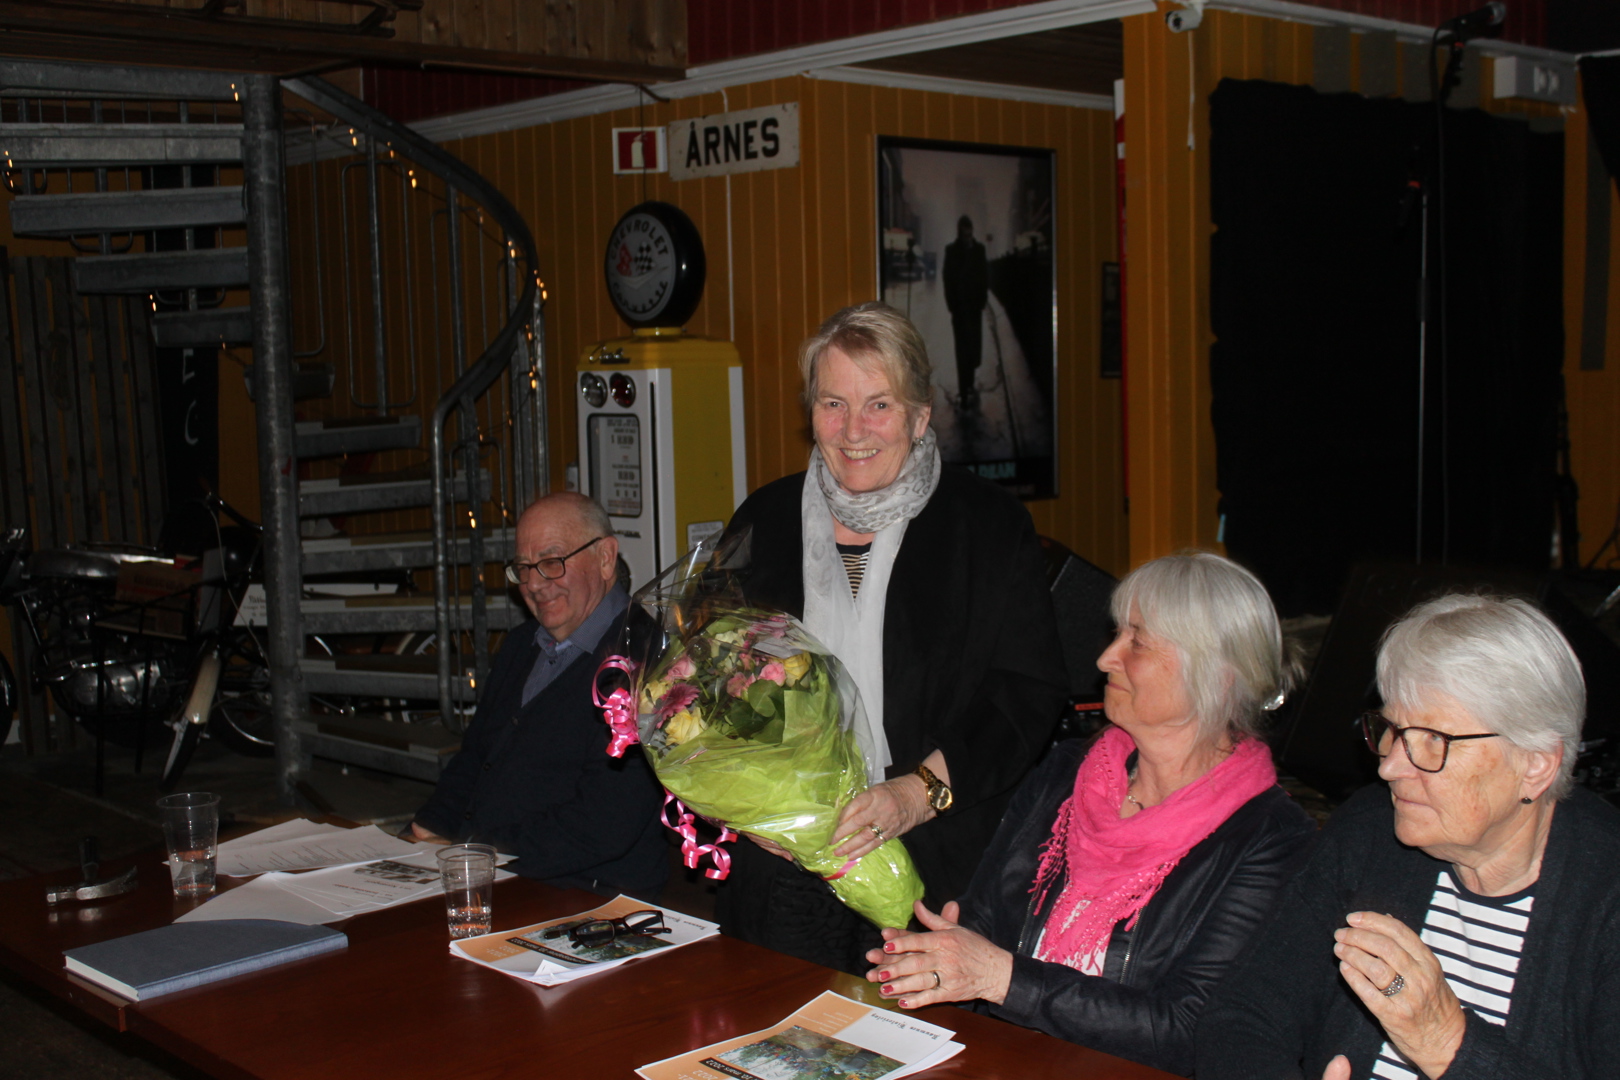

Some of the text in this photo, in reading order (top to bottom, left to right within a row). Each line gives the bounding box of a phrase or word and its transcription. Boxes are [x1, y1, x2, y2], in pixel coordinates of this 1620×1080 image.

[685, 117, 779, 168] ÅRNES
[610, 219, 669, 260] CHEVROLET
[705, 1059, 725, 1069] 2022
[724, 1066, 743, 1077] mars
